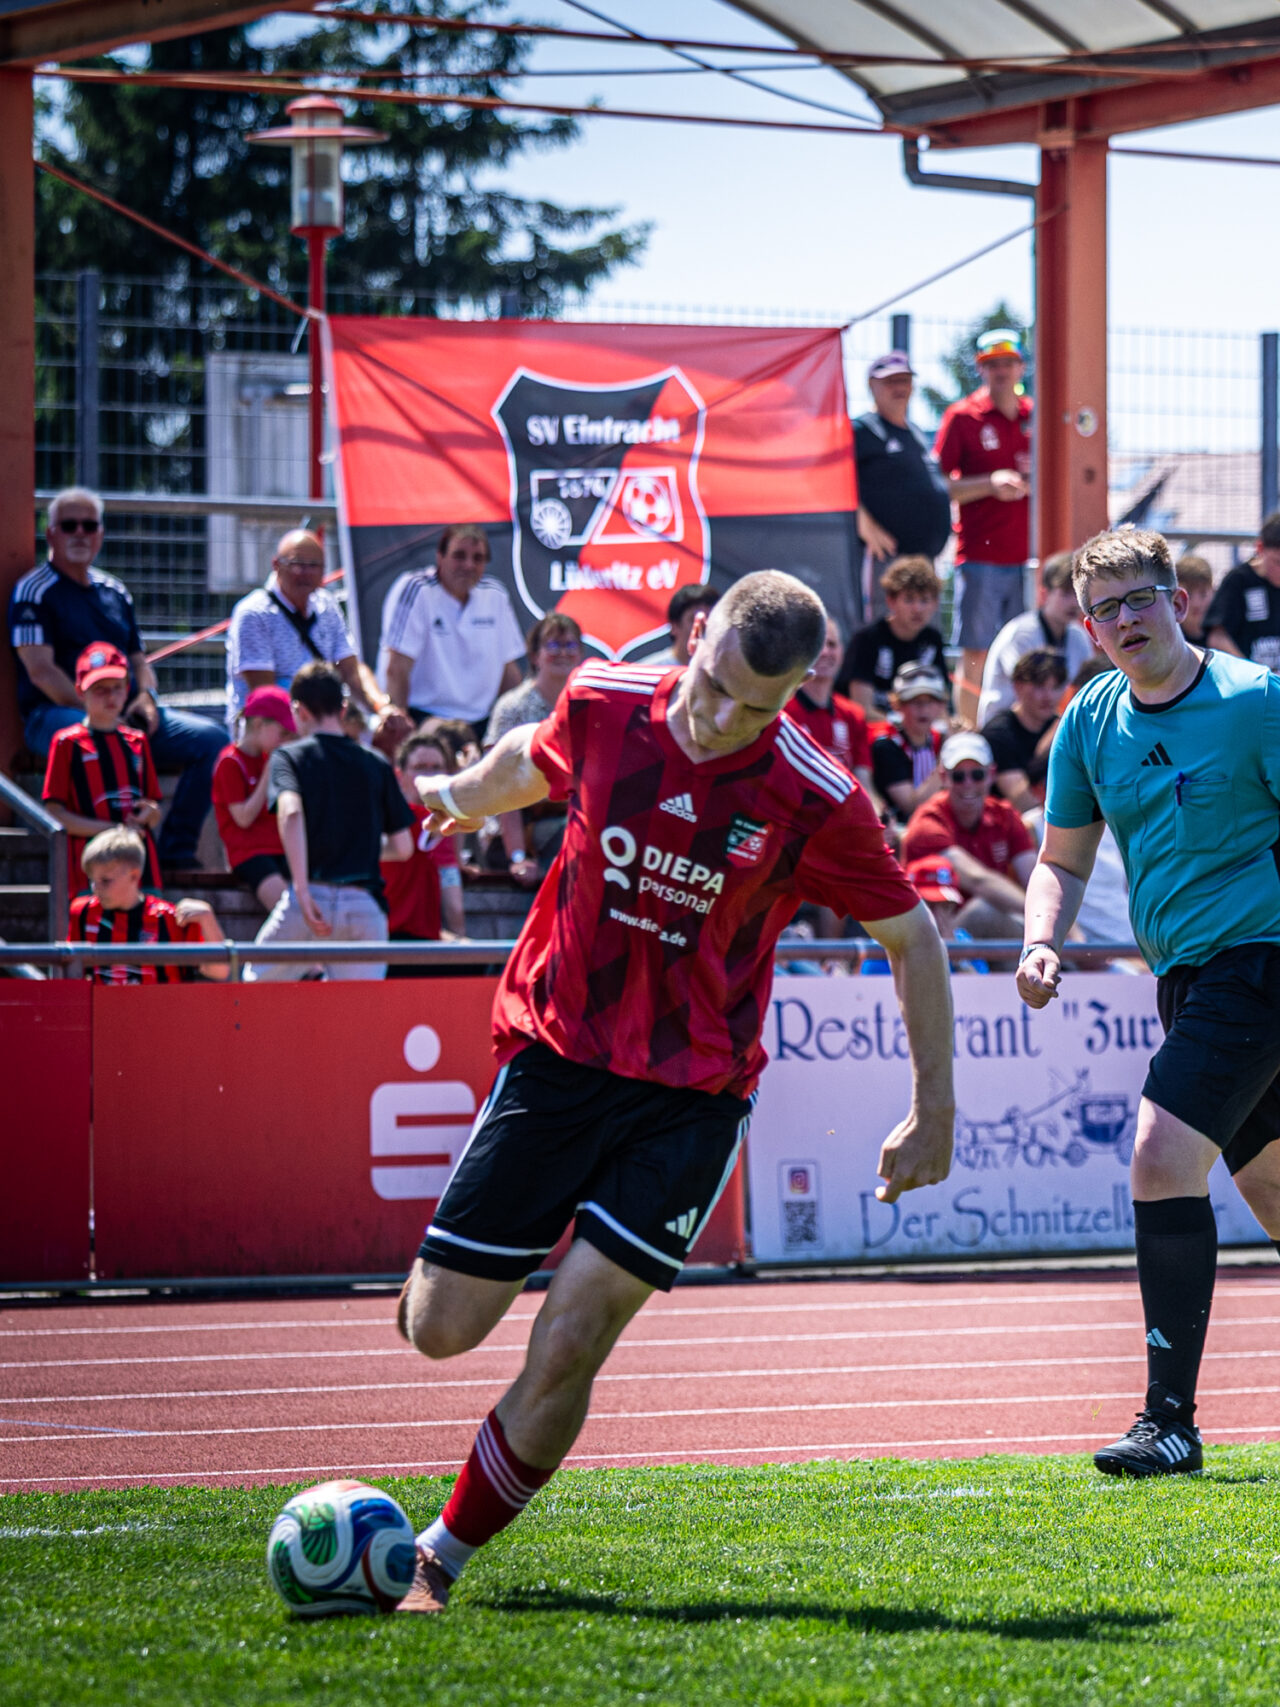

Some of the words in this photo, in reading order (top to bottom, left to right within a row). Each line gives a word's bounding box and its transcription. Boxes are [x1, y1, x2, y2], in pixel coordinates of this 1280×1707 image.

[527, 414, 559, 445] SV
[659, 801, 697, 824] adidas
[642, 845, 726, 895] DIEPA
[638, 876, 717, 914] personal
[774, 999, 1042, 1061] Restarant
[860, 1190, 942, 1249] Der
